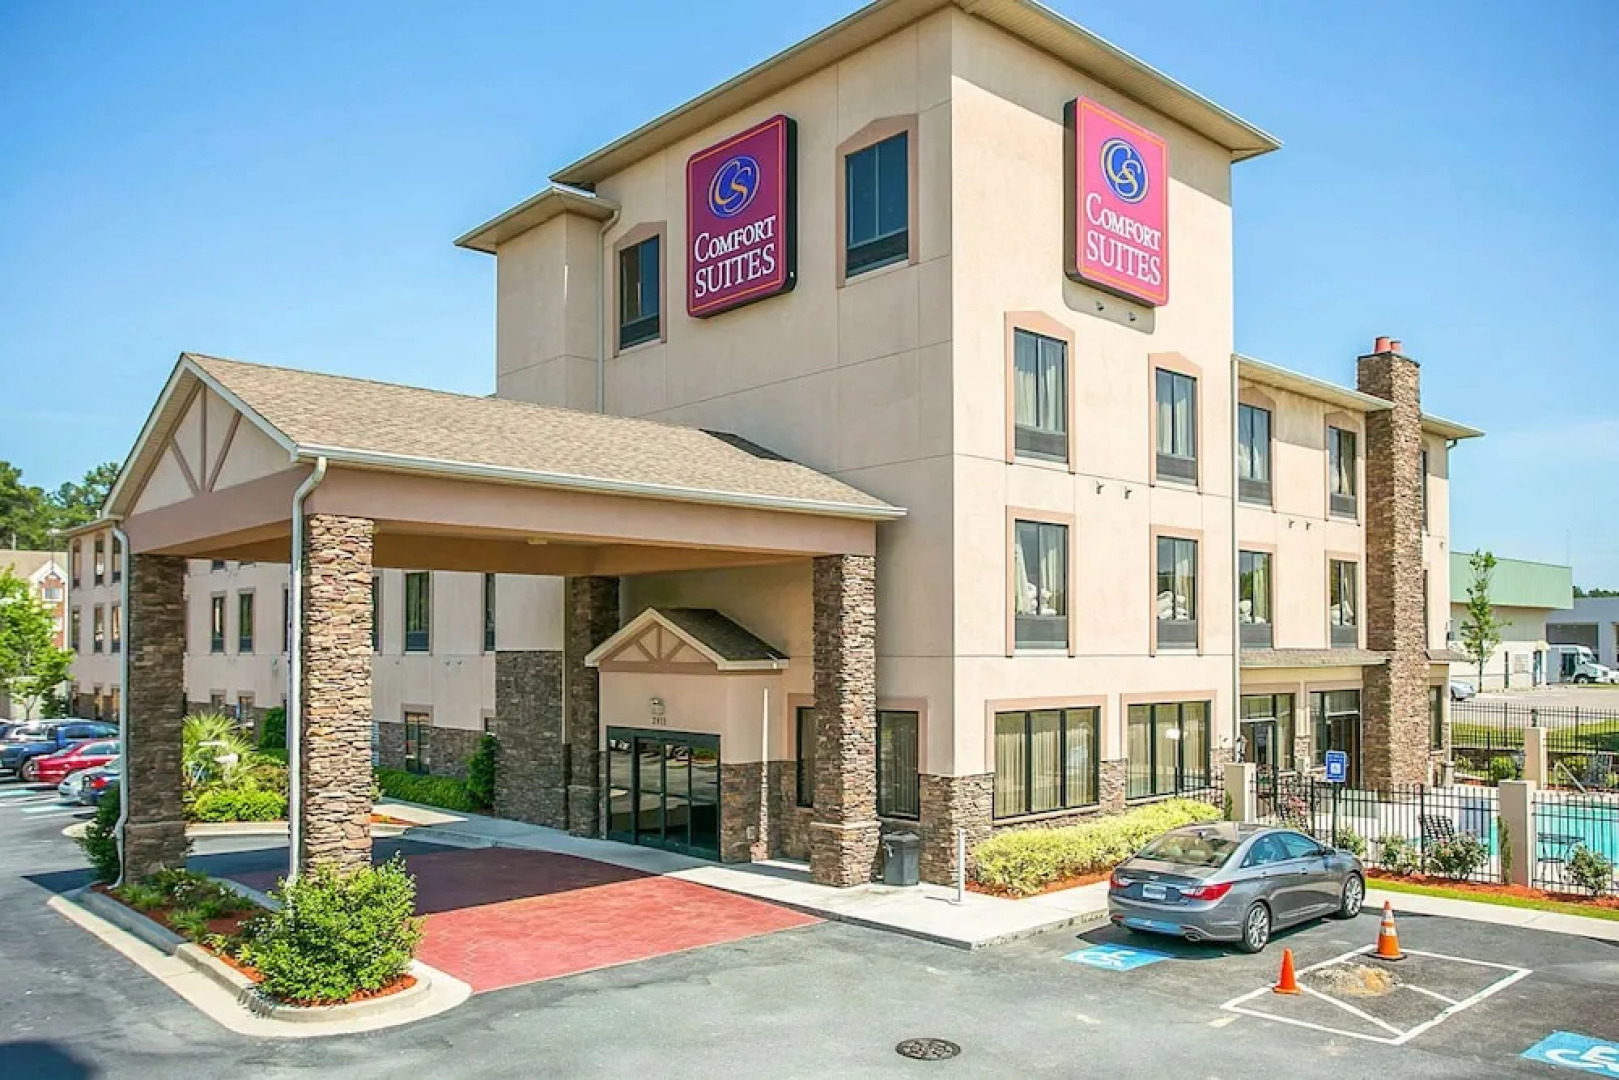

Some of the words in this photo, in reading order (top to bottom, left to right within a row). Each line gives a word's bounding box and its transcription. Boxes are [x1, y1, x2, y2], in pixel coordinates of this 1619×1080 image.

[694, 215, 776, 263] COMFORT
[1086, 193, 1161, 251] COMFORT
[694, 243, 775, 298] SUITES
[1087, 230, 1160, 285] SUITES
